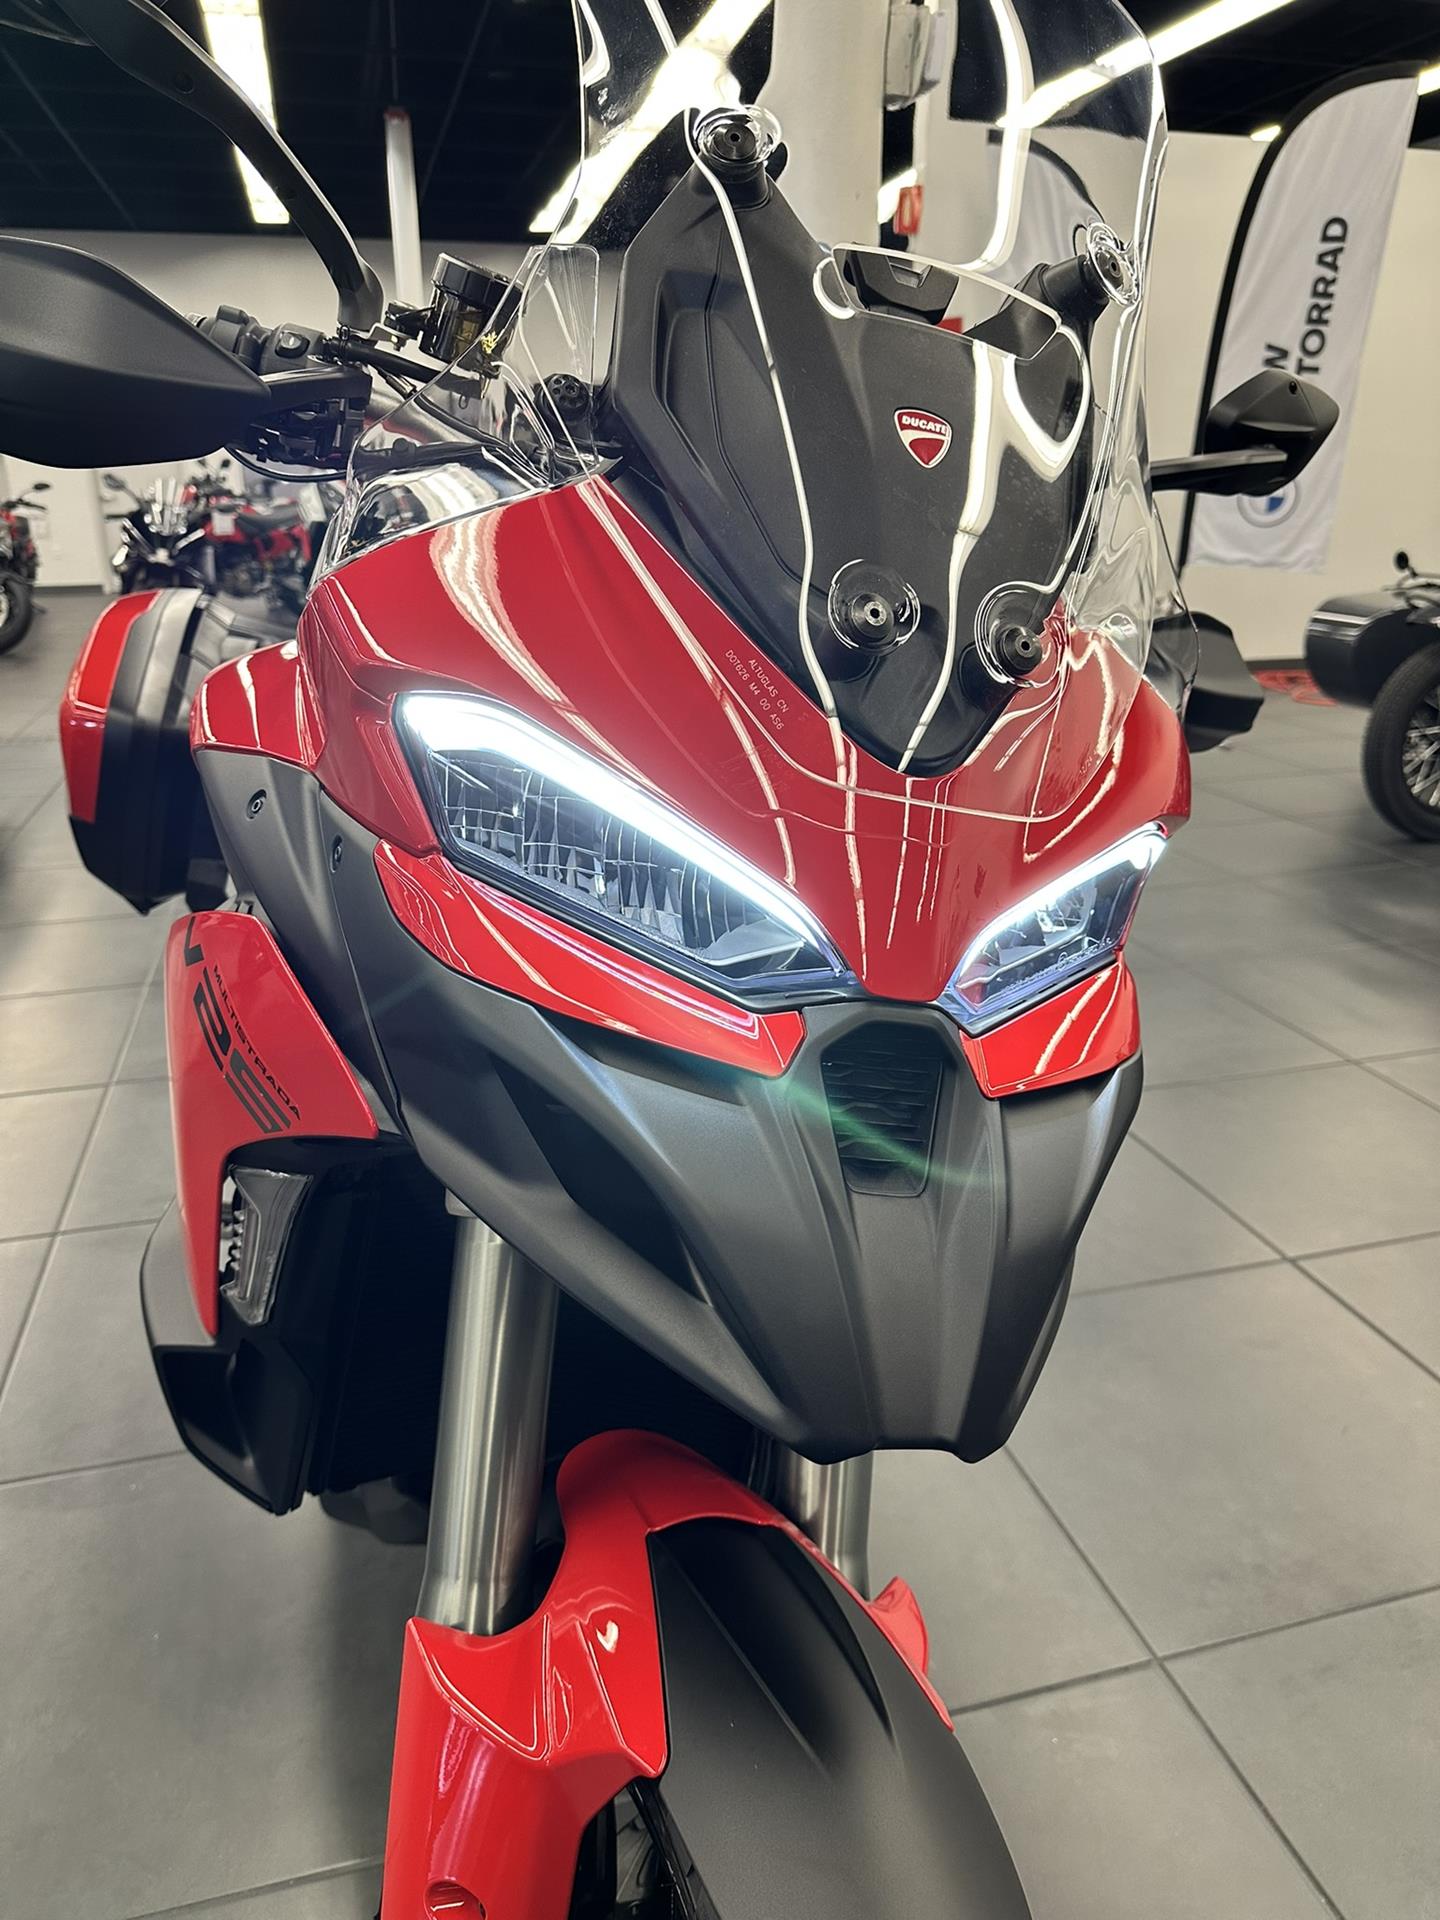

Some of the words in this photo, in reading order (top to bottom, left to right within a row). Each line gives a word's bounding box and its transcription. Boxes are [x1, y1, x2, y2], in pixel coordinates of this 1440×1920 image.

[1296, 216, 1348, 377] TORRAD
[902, 415, 946, 434] DUCATI
[725, 649, 750, 681] DOT626
[748, 682, 760, 695] M4
[770, 713, 784, 730] AS6
[748, 659, 778, 697] ALTUGLAS
[776, 699, 789, 713] CN
[213, 963, 300, 1121] MULTISTRADA
